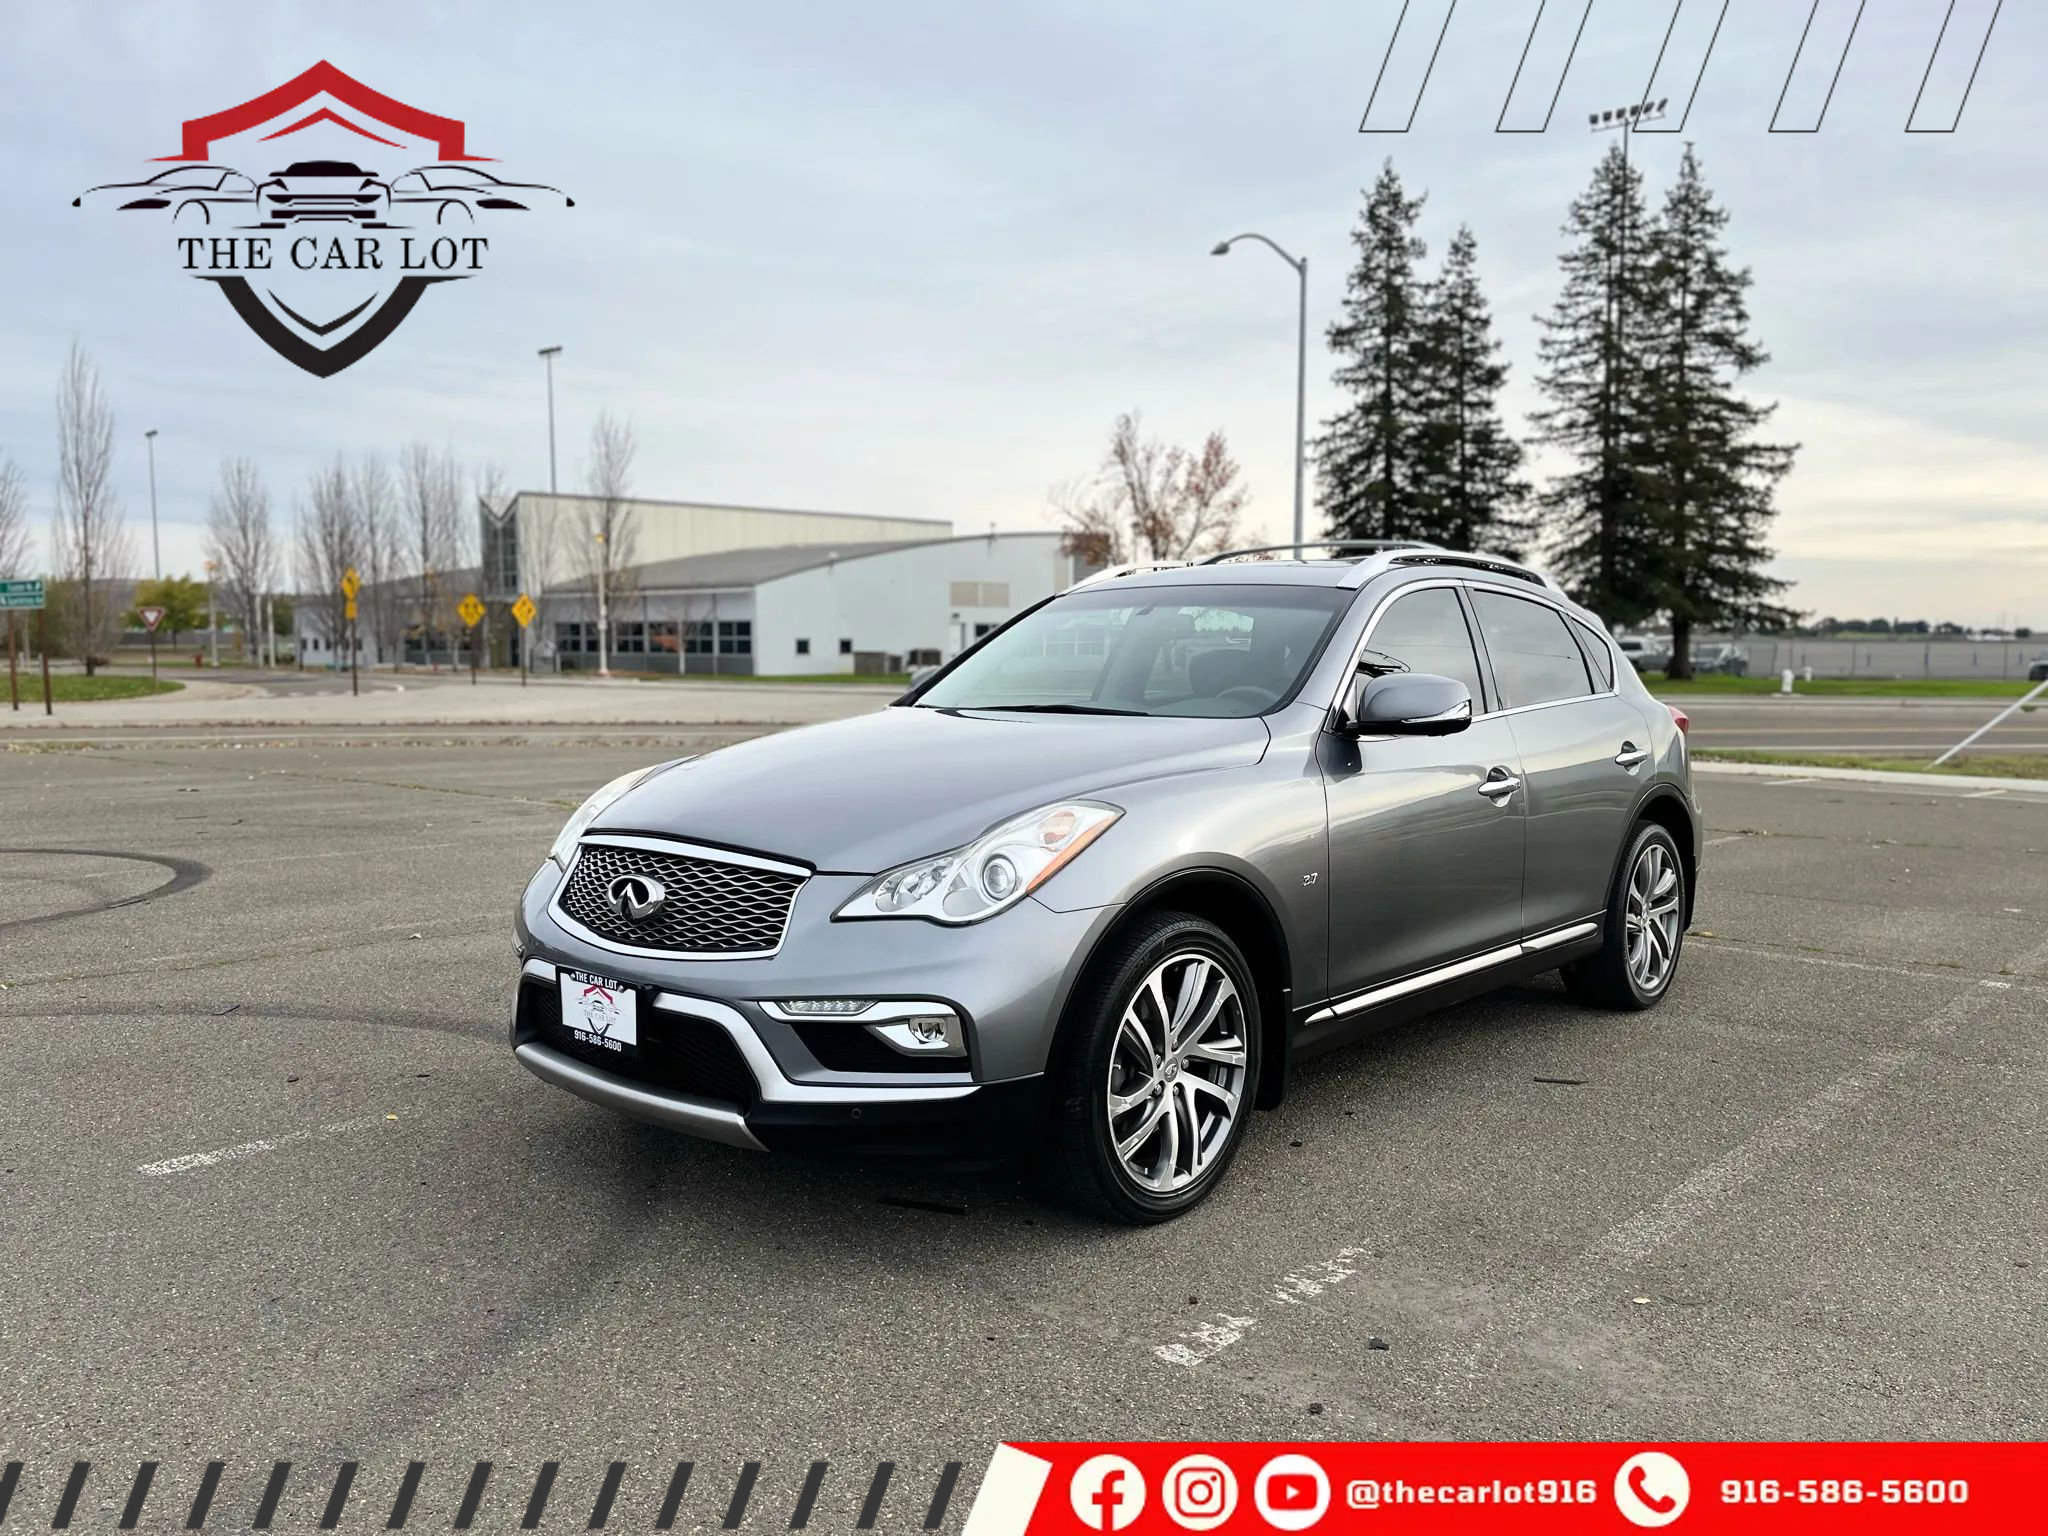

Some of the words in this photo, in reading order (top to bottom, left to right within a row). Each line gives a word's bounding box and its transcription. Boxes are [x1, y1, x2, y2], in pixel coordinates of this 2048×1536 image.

[575, 971, 588, 983] THE
[589, 975, 603, 986] CAR
[605, 978, 618, 990] LOT
[574, 1030, 622, 1052] 916-586-5600
